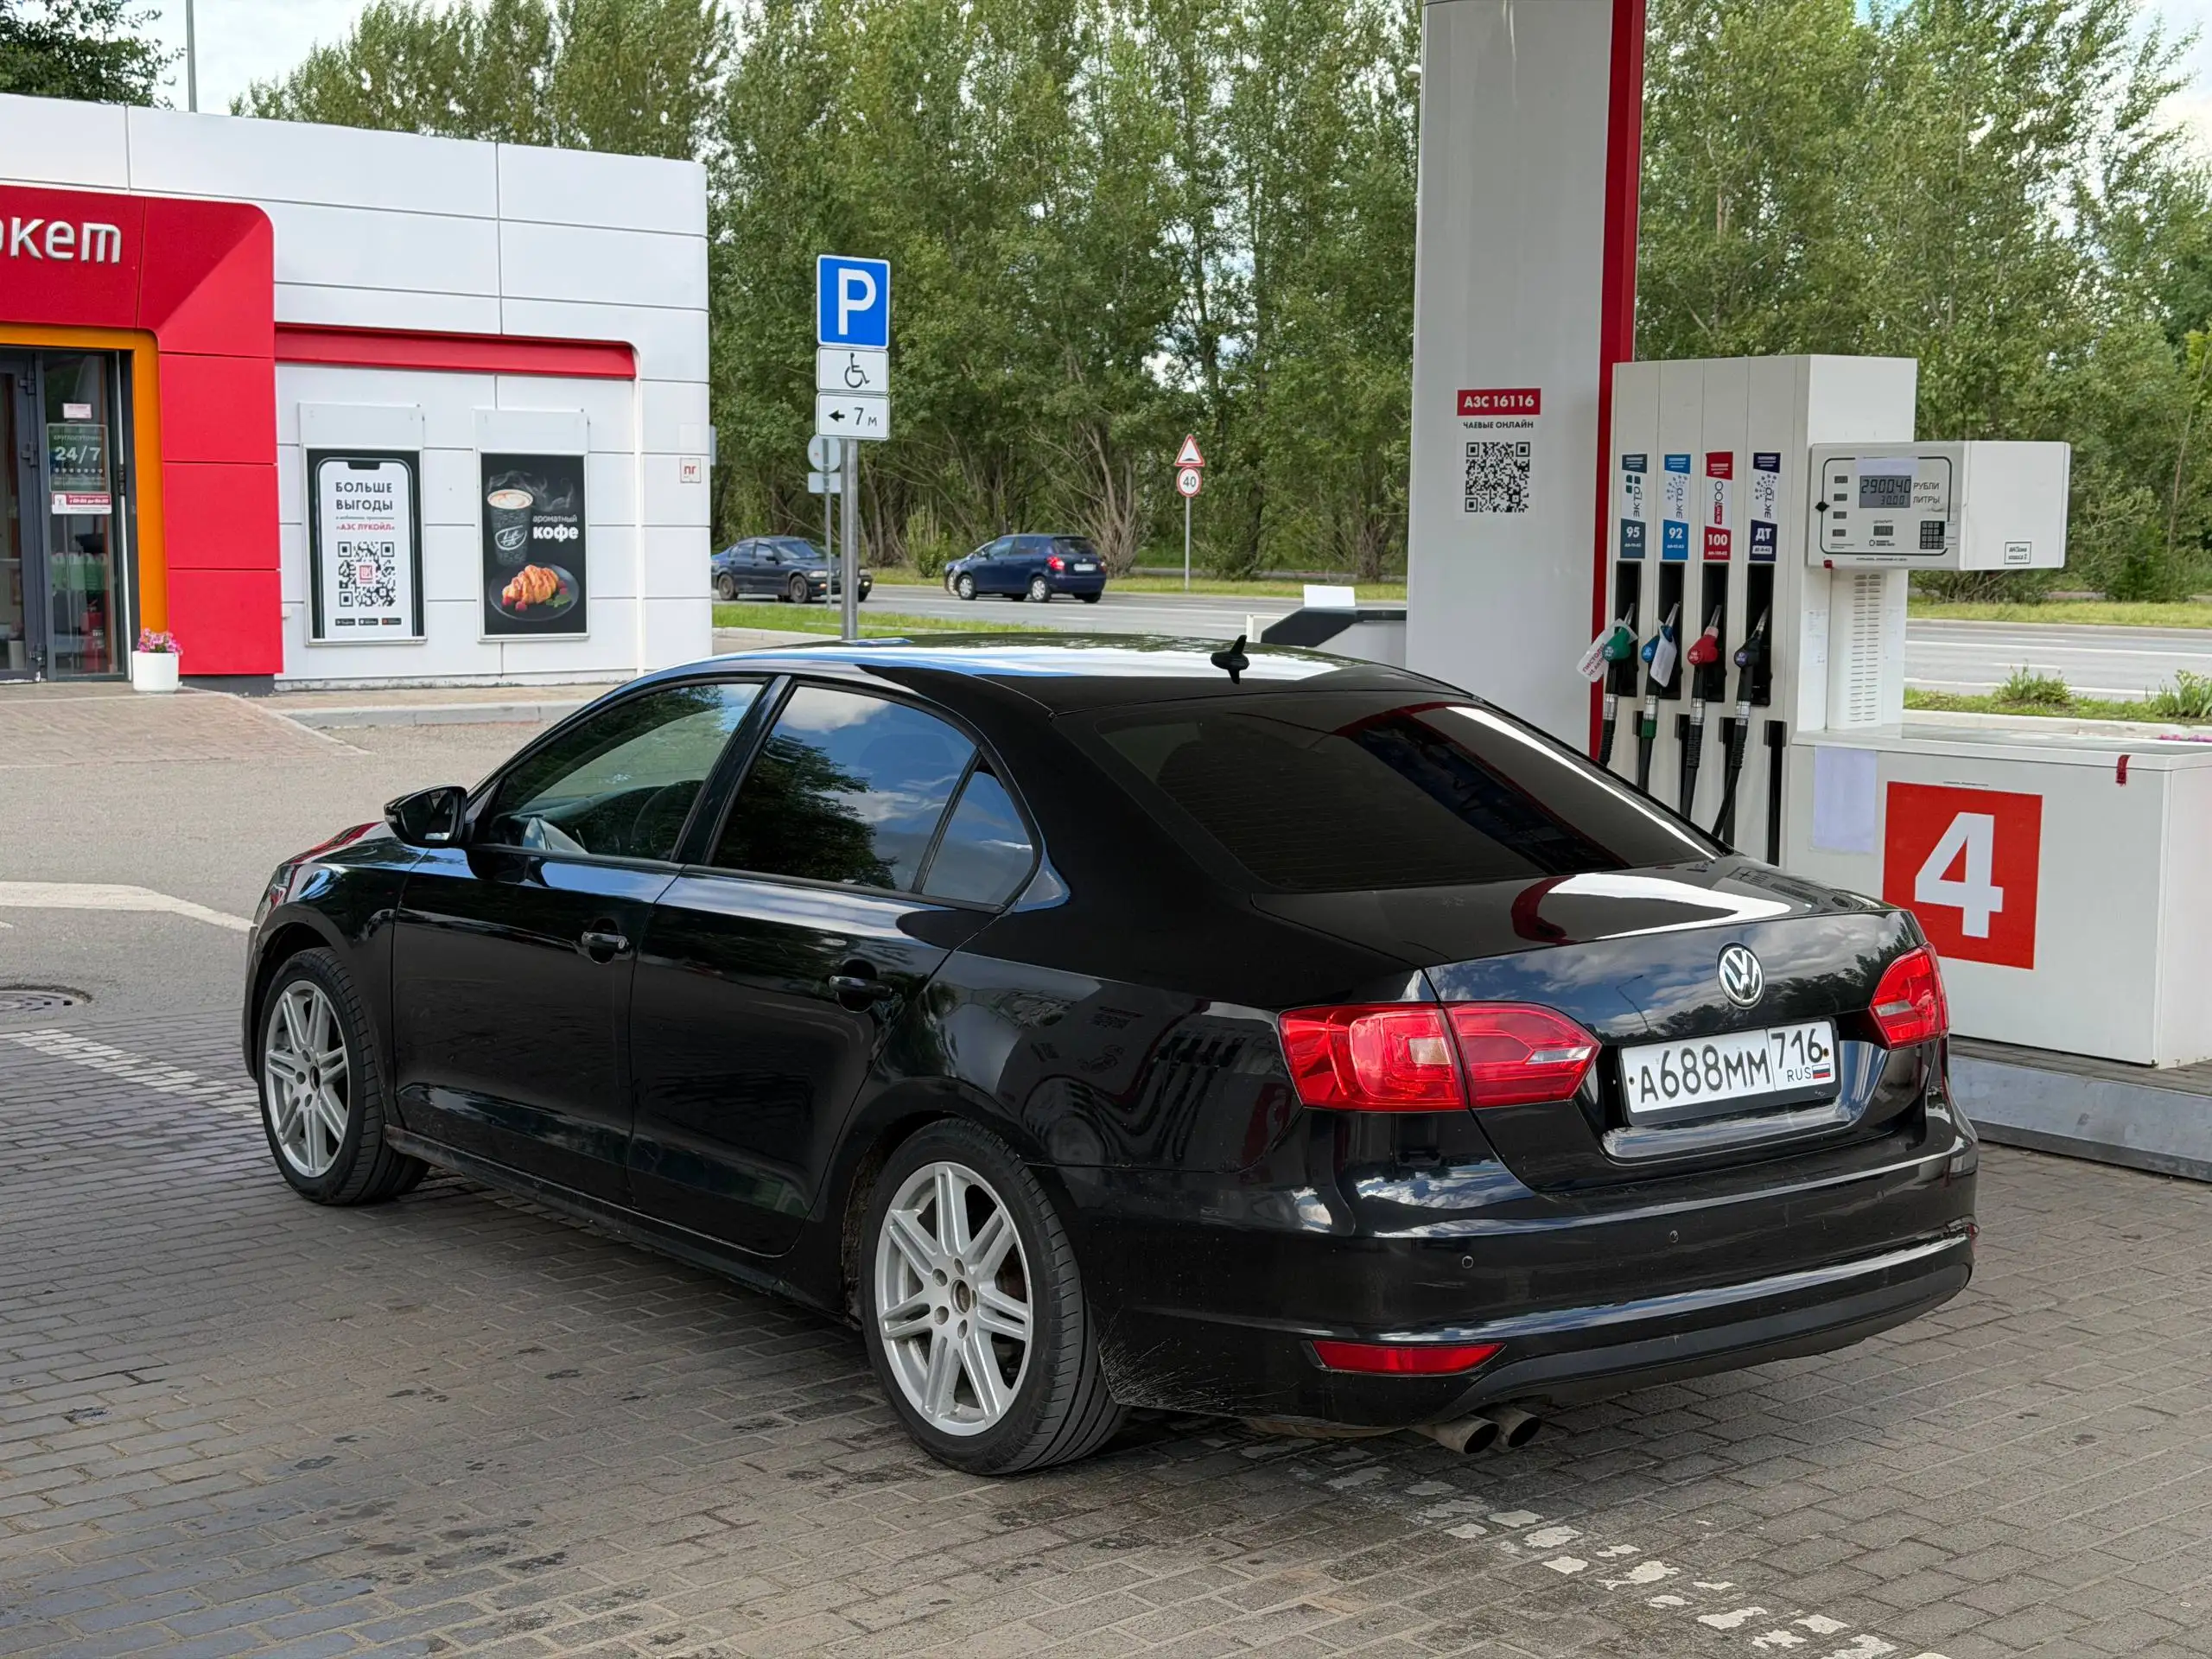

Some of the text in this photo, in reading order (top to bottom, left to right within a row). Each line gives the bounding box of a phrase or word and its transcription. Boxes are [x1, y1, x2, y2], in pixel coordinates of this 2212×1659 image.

[0, 216, 122, 264] кет
[838, 268, 877, 336] P
[1464, 395, 1535, 409] АЗС 16116
[854, 407, 864, 426] 7
[1463, 419, 1534, 429] ЧАЕВЫЕ ОНЛАЙН
[55, 446, 102, 464] 24/7
[335, 481, 393, 493] БОЛЬШЕ
[1183, 476, 1197, 487] 40
[336, 499, 393, 512] ВЫГОДЫ
[1913, 495, 1941, 505] ЛИТРЫ
[532, 514, 577, 524] ароматный
[532, 524, 579, 543] кофе
[1626, 526, 1640, 538] 95
[1669, 527, 1683, 539] 92
[1755, 528, 1773, 542] ДТ
[1707, 534, 1728, 546] 100
[1915, 811, 2004, 938] 4
[1788, 1067, 1811, 1083] RUS
